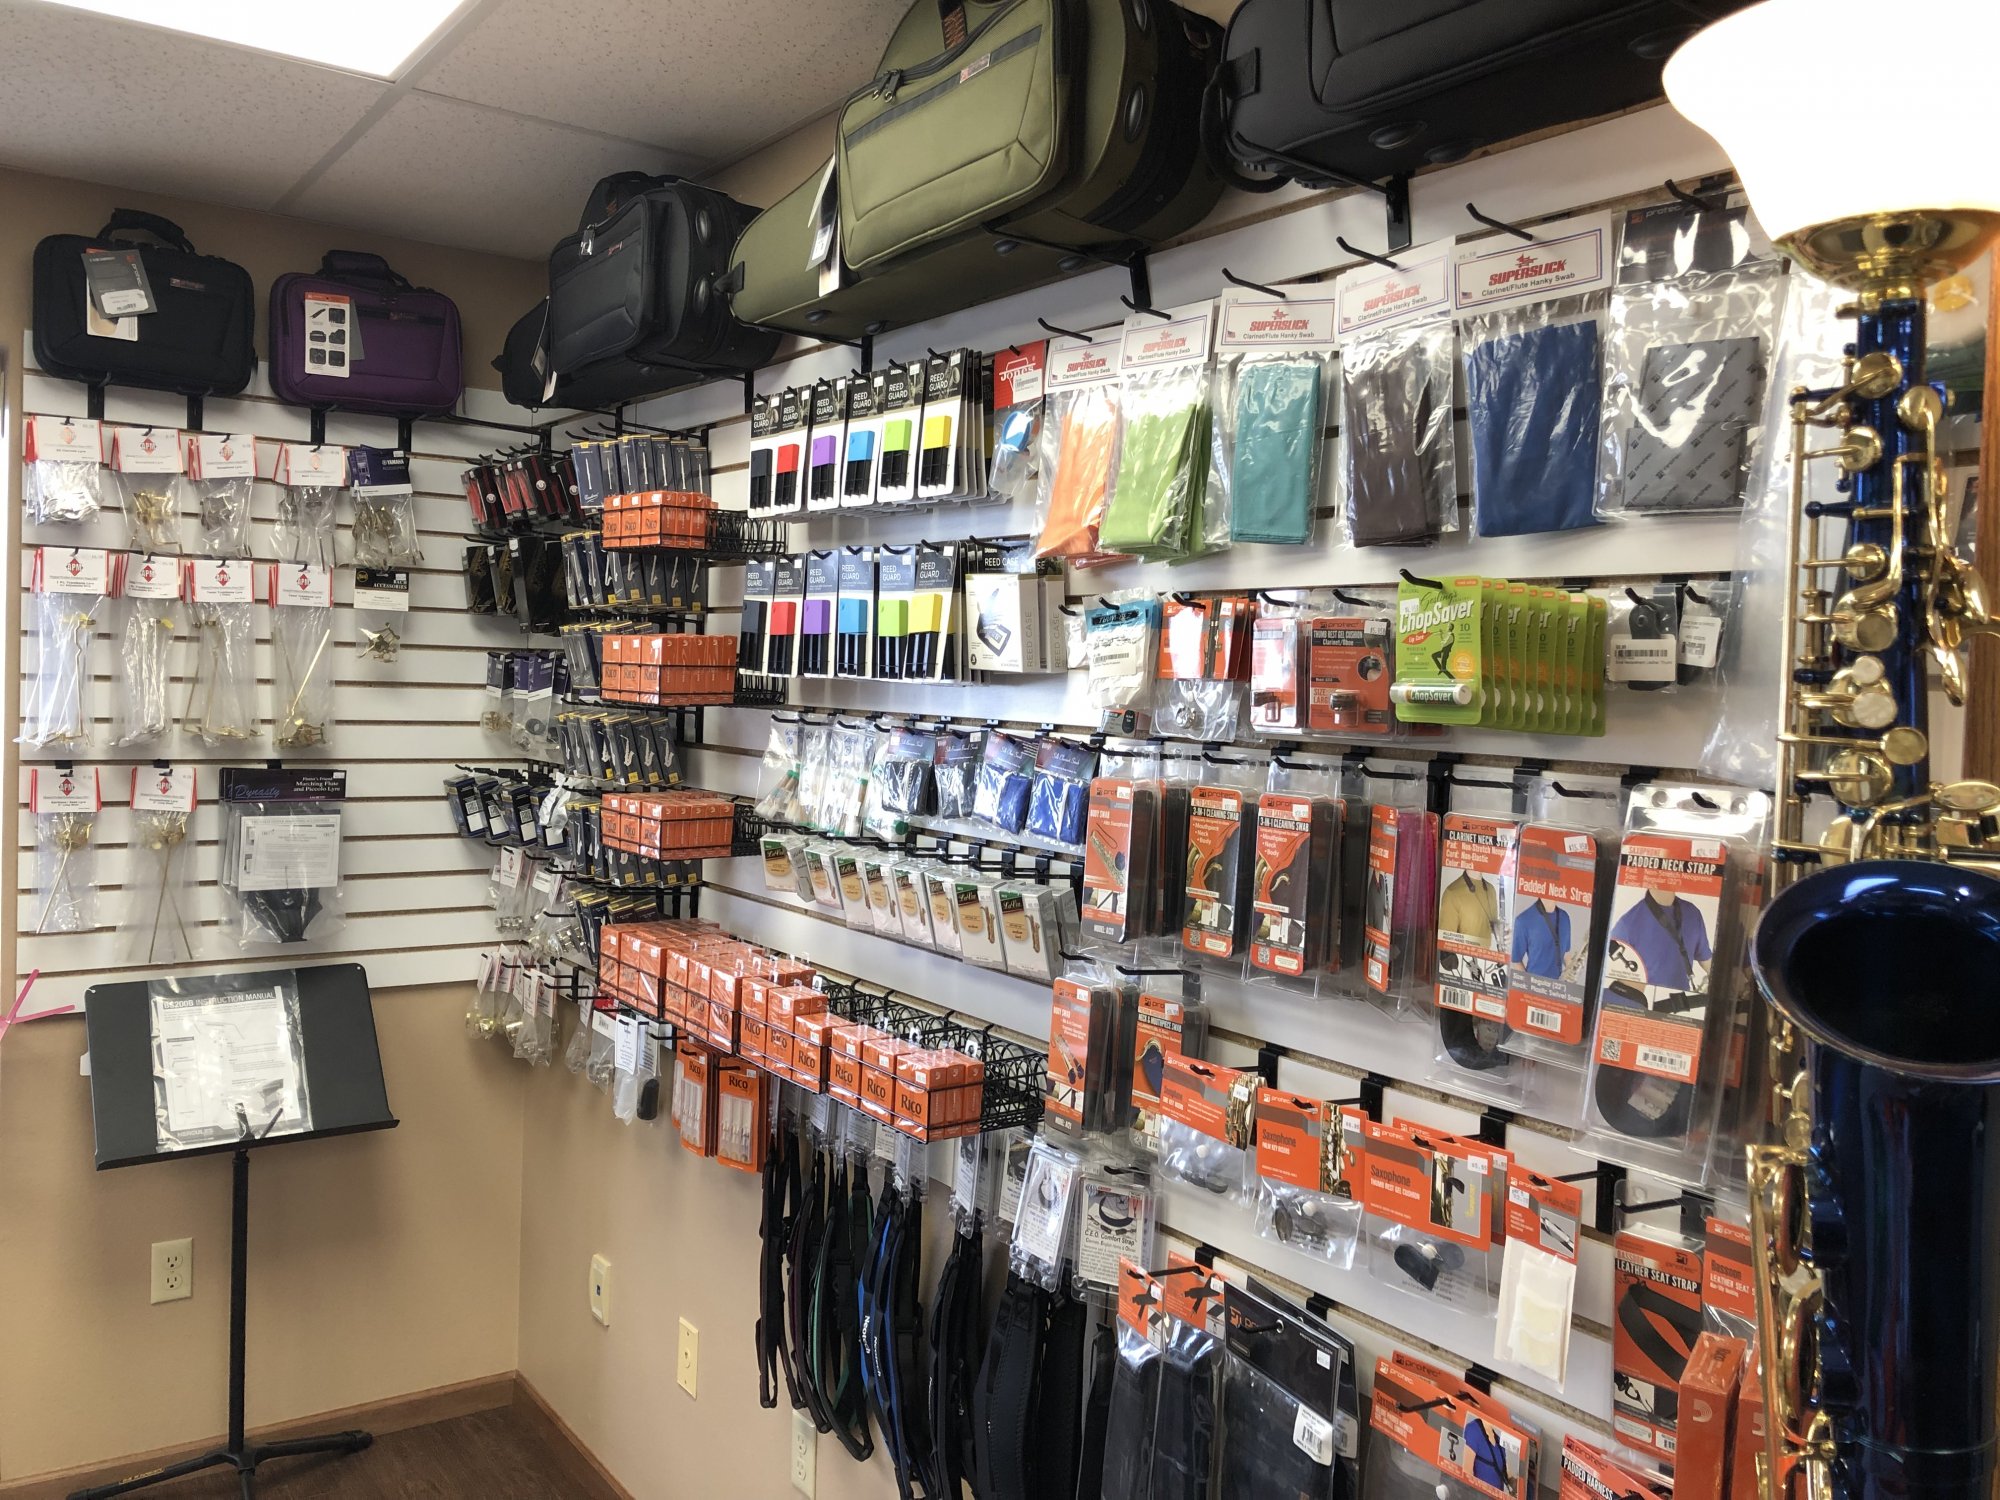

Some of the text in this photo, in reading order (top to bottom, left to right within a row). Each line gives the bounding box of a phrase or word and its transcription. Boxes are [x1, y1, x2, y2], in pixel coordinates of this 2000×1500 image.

[1489, 259, 1567, 286] SUPERSLICK
[1482, 271, 1575, 297] Clarinet/Flute Hanky Swab
[1364, 284, 1421, 312] SUPERSLICK
[1358, 296, 1428, 322] Clarinet/Flute Hanky Swab
[1250, 319, 1309, 331] SUPERSLICK
[1143, 336, 1188, 353] SUPERSLICK
[1137, 352, 1165, 361] Clarinet/Flute
[1067, 358, 1107, 372] SUPERSLICK
[930, 373, 945, 382] REED
[888, 383, 904, 392] REED
[929, 380, 949, 391] GUARD
[853, 392, 868, 400] REED
[888, 390, 908, 400] GUARD
[816, 399, 830, 407] REED
[853, 400, 872, 409] GUARD
[783, 406, 796, 414] REED
[816, 406, 834, 415] GUARD
[754, 413, 766, 421] REED
[783, 413, 799, 422] GUARD
[754, 419, 769, 428] GUARD
[920, 562, 936, 570] REED
[984, 557, 1019, 566] REED CASE
[809, 568, 823, 576] REED
[882, 573, 902, 581] GUARD
[920, 570, 940, 578] GUARD
[1399, 599, 1475, 634] ChopSaver
[1460, 624, 1470, 632] 10
[1313, 630, 1327, 639] THUMB
[1327, 630, 1337, 639] REST
[1337, 630, 1345, 639] GEL
[1345, 630, 1363, 639] CUSHION
[1313, 688, 1326, 696] SIZE
[1411, 689, 1452, 701] ChopSaver
[234, 784, 280, 799] Dynasty
[1206, 791, 1234, 799] protec
[1192, 806, 1240, 821] 3-IN-1 CLEANING SWAB
[1195, 822, 1219, 831] Mouthpiece
[1260, 818, 1309, 832] 3-IN-1 CLEANING SWAB
[1471, 824, 1497, 832] prote
[1200, 837, 1211, 845] Body
[1262, 834, 1288, 843] Mouthpiece
[1449, 831, 1494, 846] CLARINET NECK
[1267, 849, 1279, 857] Body
[1446, 841, 1491, 853] Pad: Non-Stretch
[1460, 852, 1489, 862] Non-Elastic
[1460, 861, 1475, 869] Black
[1626, 855, 1716, 875] PADDED NECK STRAP
[1519, 877, 1592, 904] Padded Neck Strap
[1530, 975, 1551, 986] Regular
[195, 995, 244, 1006] INSTRUCTION
[245, 992, 276, 1001] MANUAL
[1548, 988, 1567, 999] Swivel
[1567, 994, 1582, 1004] Snap
[744, 1018, 761, 1036] RICO
[798, 1051, 816, 1069] RICO
[689, 1061, 700, 1074] RICO
[835, 1064, 853, 1084] RICO
[729, 1075, 748, 1090] RICO
[867, 1079, 886, 1099] RICO
[901, 1094, 922, 1115] RICO
[1271, 1096, 1291, 1104] protec
[1262, 1129, 1297, 1147] Saxophone
[1381, 1130, 1404, 1140] protec
[1370, 1164, 1411, 1187] Saxophone
[1100, 1233, 1135, 1246] Comfort Strap
[1616, 1260, 1698, 1292] LEATHER SEAT STRAP
[1709, 1273, 1750, 1293] LEATHER SEAT
[1404, 1358, 1436, 1377] protec
[1389, 1367, 1414, 1385] protec
[1575, 1444, 1606, 1470] protec
[1563, 1457, 1586, 1480] PADDED
[1586, 1470, 1614, 1500] HARNESS
